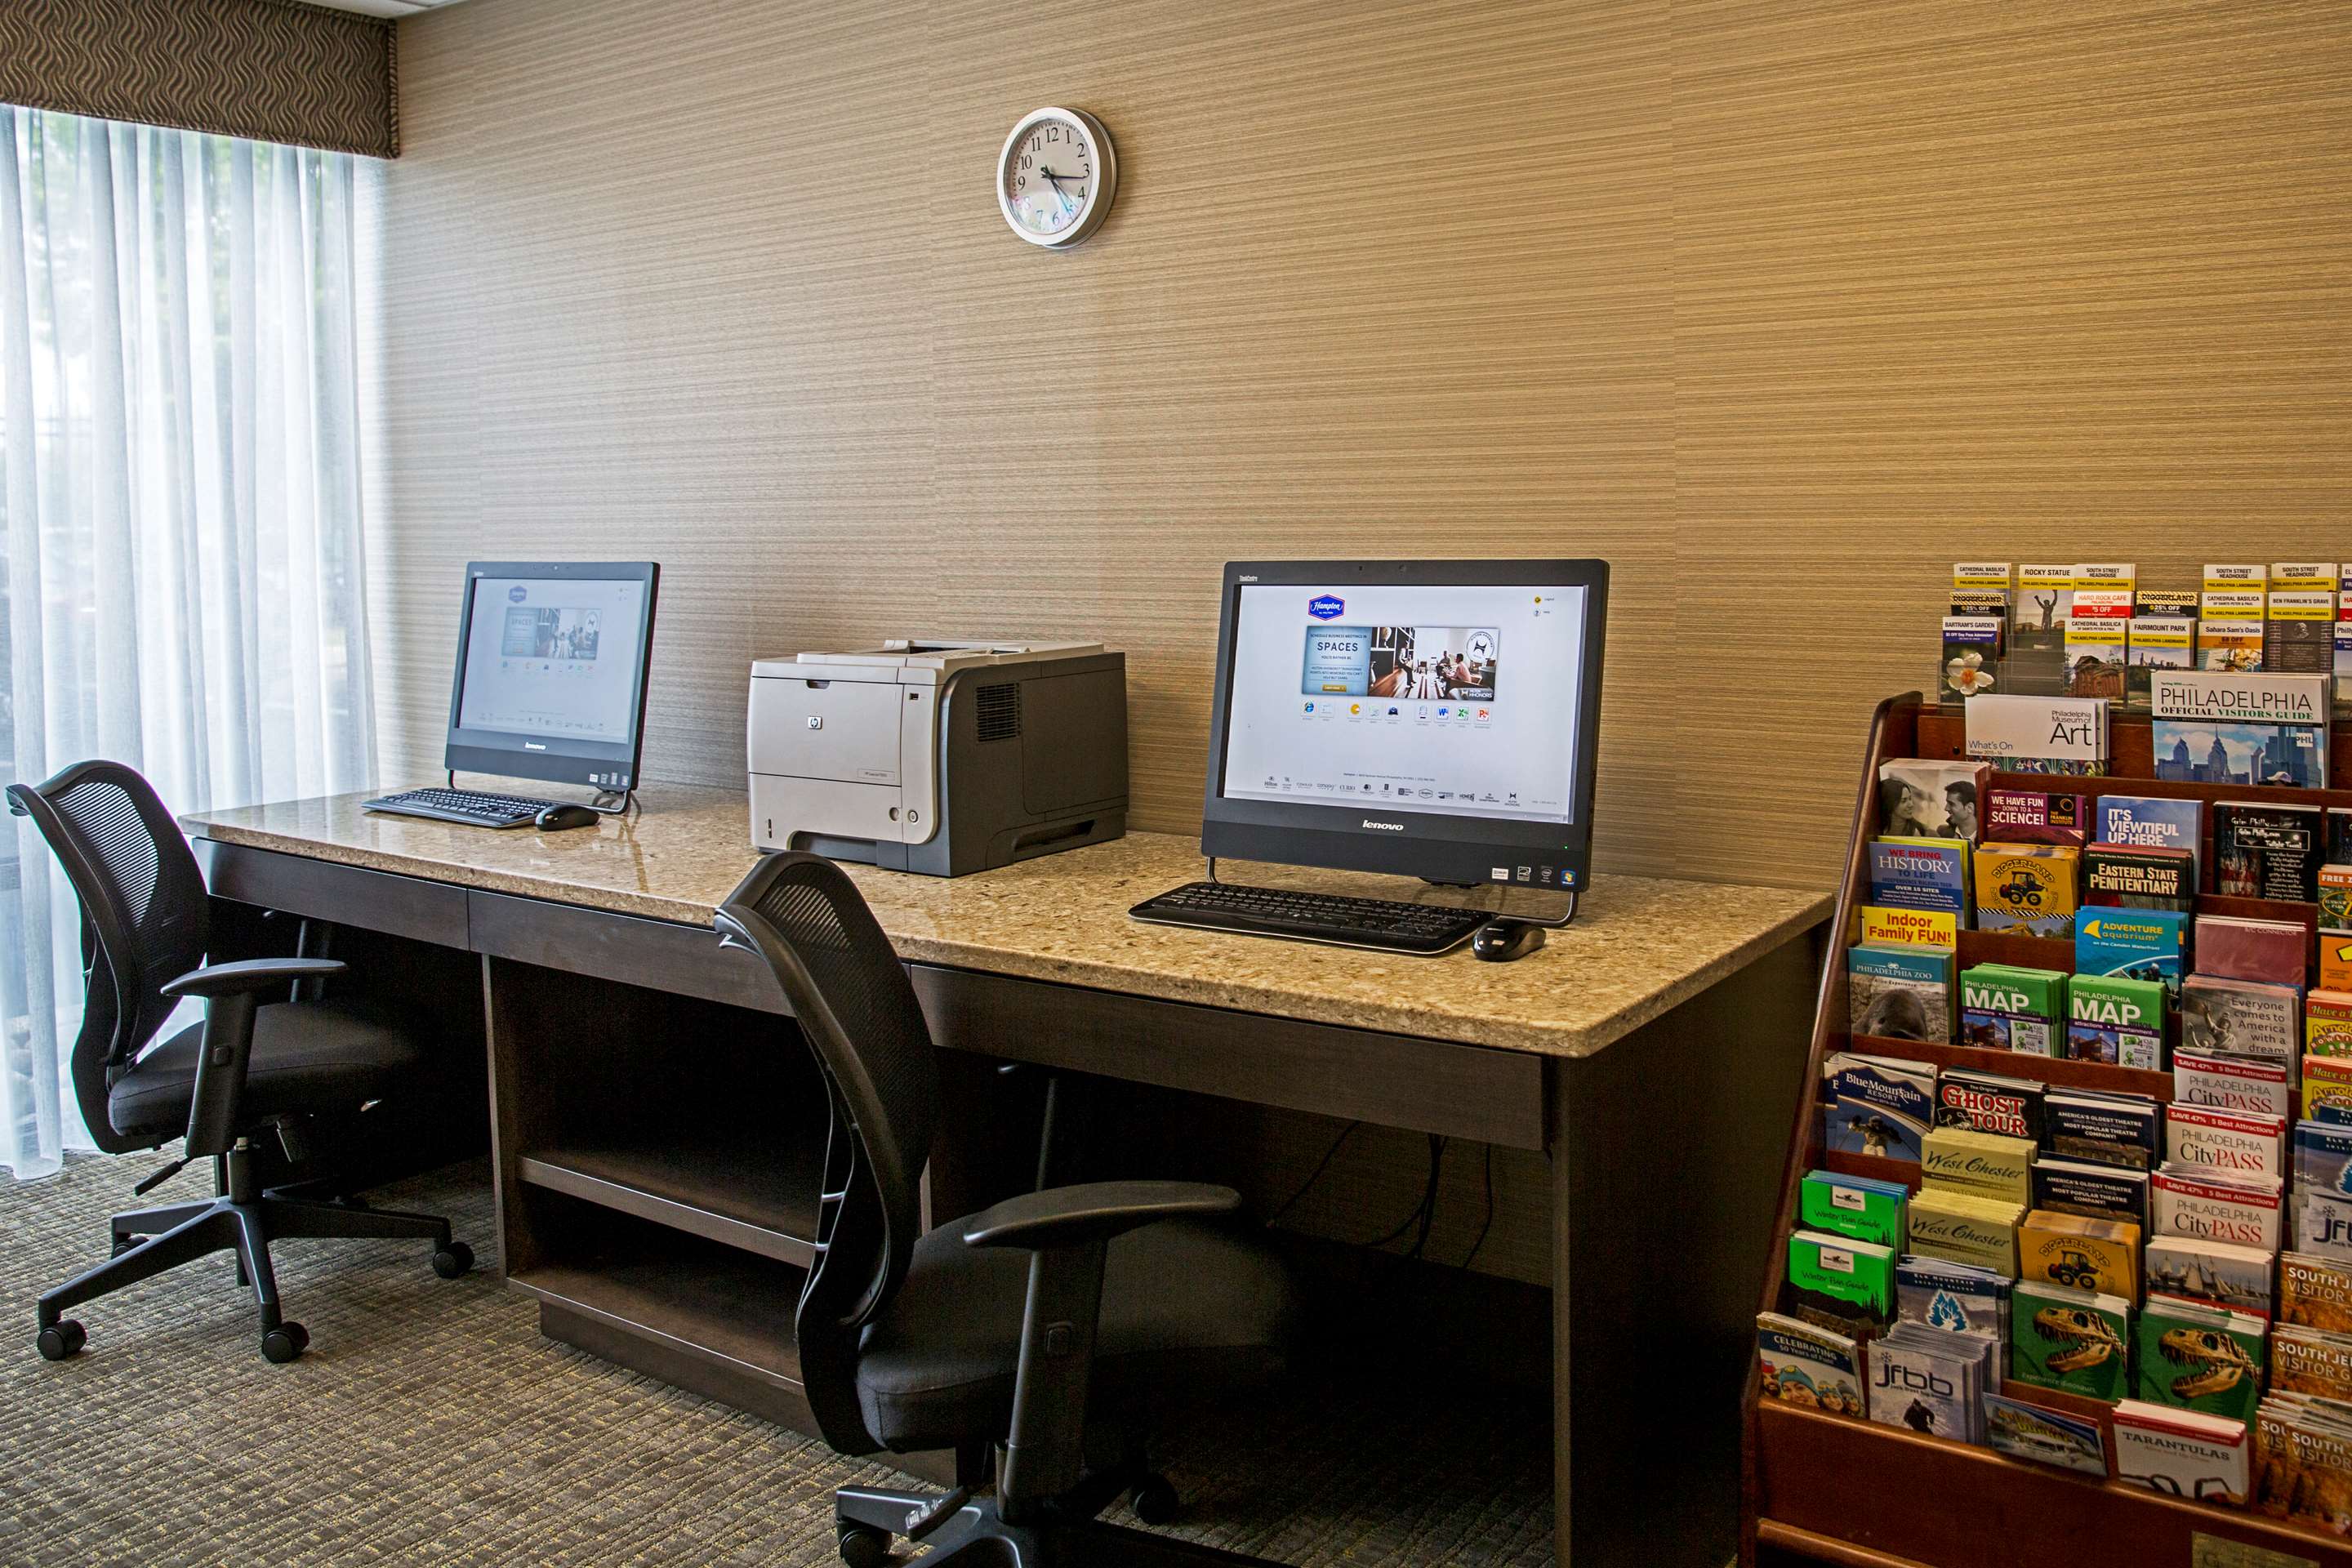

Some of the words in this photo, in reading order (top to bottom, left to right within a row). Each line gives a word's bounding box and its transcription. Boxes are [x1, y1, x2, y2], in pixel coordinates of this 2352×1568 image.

[1046, 127, 1058, 144] 12
[1066, 130, 1071, 144] 1
[1031, 136, 1041, 152] 11
[1077, 143, 1085, 158] 2
[1021, 155, 1032, 170] 10
[1085, 163, 1090, 178] 3
[1018, 176, 1026, 190] 9
[1077, 186, 1085, 200] 4
[1036, 210, 1044, 225] 7
[1052, 211, 1059, 225] 6
[1311, 602, 1343, 611] Hampton
[1317, 642, 1358, 652] SPACES
[2161, 688, 2312, 710] PHILADELPHIA
[2051, 710, 2091, 719] Philadelphia
[2161, 706, 2214, 715] OFFICIAL
[2217, 708, 2272, 718] VISITORS
[2050, 723, 2092, 746] Art
[524, 742, 546, 751] lenovo
[1968, 740, 1998, 750] What's
[1999, 742, 2013, 750] On
[1991, 796, 2004, 804] WE
[2006, 797, 2026, 806] HAVE
[2028, 798, 2043, 807] FUN
[1992, 812, 2043, 825] SCIENCE!
[2108, 808, 2132, 822] IT'S
[1362, 820, 1404, 831] lenovo
[2108, 821, 2180, 836] VIEWTIFUL
[2108, 832, 2127, 844] UP
[2129, 834, 2167, 846] HERE.
[1889, 849, 1904, 857] WE
[1908, 851, 1940, 860] BRING
[1878, 856, 1953, 874] HISTORY
[1992, 859, 2056, 882] DIGGERLAND
[2099, 863, 2144, 879] EASTERN
[2147, 866, 2178, 881] STATE
[1914, 871, 1936, 880] LIFE
[2090, 874, 2178, 894] PENITENTIARY
[1887, 913, 1932, 928] Indoor
[1869, 926, 1913, 942] Family
[1918, 931, 1951, 942] FUN!
[2103, 923, 2163, 934] ADVENTURE
[2103, 932, 2154, 942] aquarium
[1857, 964, 1912, 978] PHILADELPHIA
[1965, 981, 2019, 992] PHILADELPHIA
[1965, 987, 2029, 1013] MAP
[2074, 990, 2131, 1004] PHILADELPHIA
[2231, 997, 2284, 1011] Everyone
[2074, 998, 2140, 1025] MAP
[2234, 1011, 2270, 1021] comes
[2274, 1013, 2285, 1022] to
[2312, 1005, 2337, 1016] Have
[2114, 1026, 2153, 1036] entertainment
[2238, 1020, 2285, 1034] America
[2251, 1033, 2275, 1044] with
[2279, 1036, 2286, 1045] a
[2249, 1044, 2284, 1053] dream
[2178, 1059, 2197, 1067] SAVE
[2242, 1070, 2282, 1080] Attractions
[1846, 1073, 1921, 1102] BlueMountain
[2189, 1076, 2271, 1096] PHILADELPHIA
[1867, 1089, 1898, 1102] RESORT
[1942, 1085, 2025, 1116] GHOST
[2189, 1088, 2273, 1113] CityPASS
[1969, 1111, 2029, 1136] TOUR
[2058, 1111, 2089, 1120] AMERICA'S
[2114, 1118, 2142, 1127] THEATRE
[2082, 1125, 2109, 1133] POPULAR
[2110, 1128, 2138, 1137] THEATRE
[2085, 1130, 2117, 1139] COMPANY!
[2182, 1129, 2263, 1153] PHILADELPHIA
[1927, 1150, 1961, 1169] West
[1965, 1157, 2025, 1178] Chester
[2180, 1142, 2264, 1171] CityPASS
[2177, 1200, 2262, 1224] PHILADELPHIA
[2175, 1213, 2261, 1242] CityPASS
[2288, 1267, 2337, 1286] SOUTH
[2288, 1280, 2345, 1303] VISITOR
[1774, 1335, 1837, 1360] CELEBRATING
[2277, 1341, 2327, 1361] SOUTH
[2277, 1354, 2334, 1378] VISITOR
[2123, 1432, 2230, 1461] TARANTULAS
